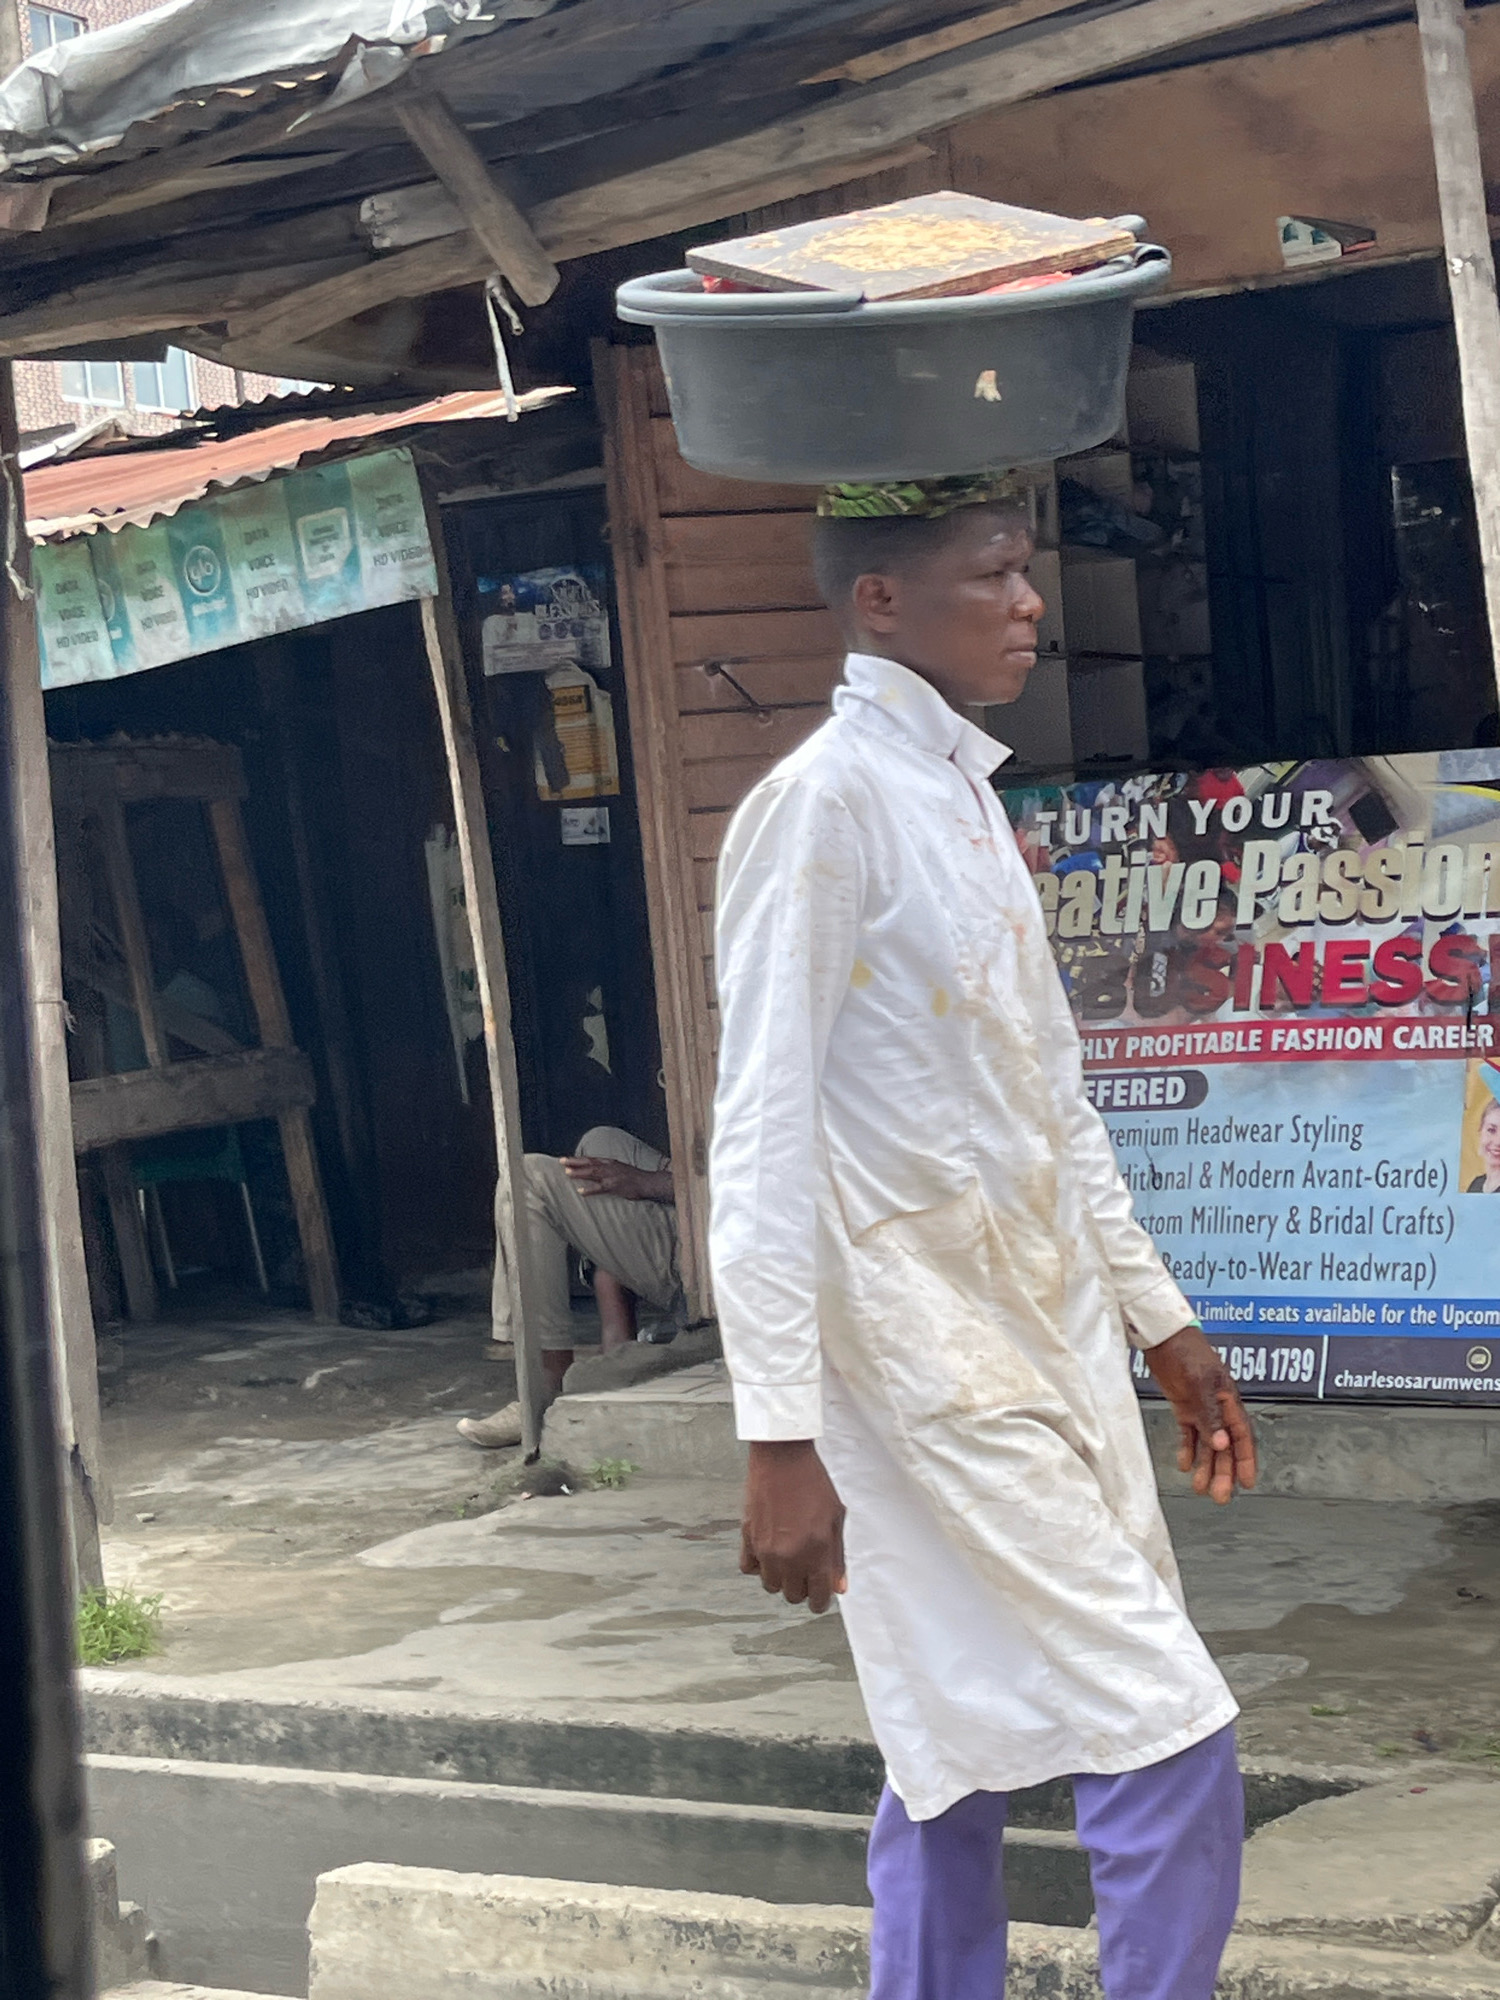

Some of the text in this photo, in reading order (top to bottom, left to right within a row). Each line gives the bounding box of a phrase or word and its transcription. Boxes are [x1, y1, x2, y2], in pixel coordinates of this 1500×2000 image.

[1035, 789, 1334, 847] TURN YOUR
[1125, 1029, 1263, 1058] PROFITABLE
[1271, 1026, 1383, 1051] FASHION
[1393, 1024, 1494, 1049] CAREER
[1104, 1115, 1364, 1152] remium Headwear Styling
[1200, 1161, 1213, 1189] &
[1220, 1160, 1295, 1189] Modern
[1302, 1159, 1448, 1197] Avant-Garde)
[1135, 1205, 1455, 1244] stom Millinery & Bridal Crafts)
[1162, 1251, 1437, 1291] Ready-to-Wear Headwrap)
[1196, 1301, 1500, 1331] Limited seats available for the Upcom
[1229, 1346, 1267, 1382] 954
[1270, 1347, 1316, 1383] 1739
[1334, 1369, 1500, 1391] charlesosarumwens
